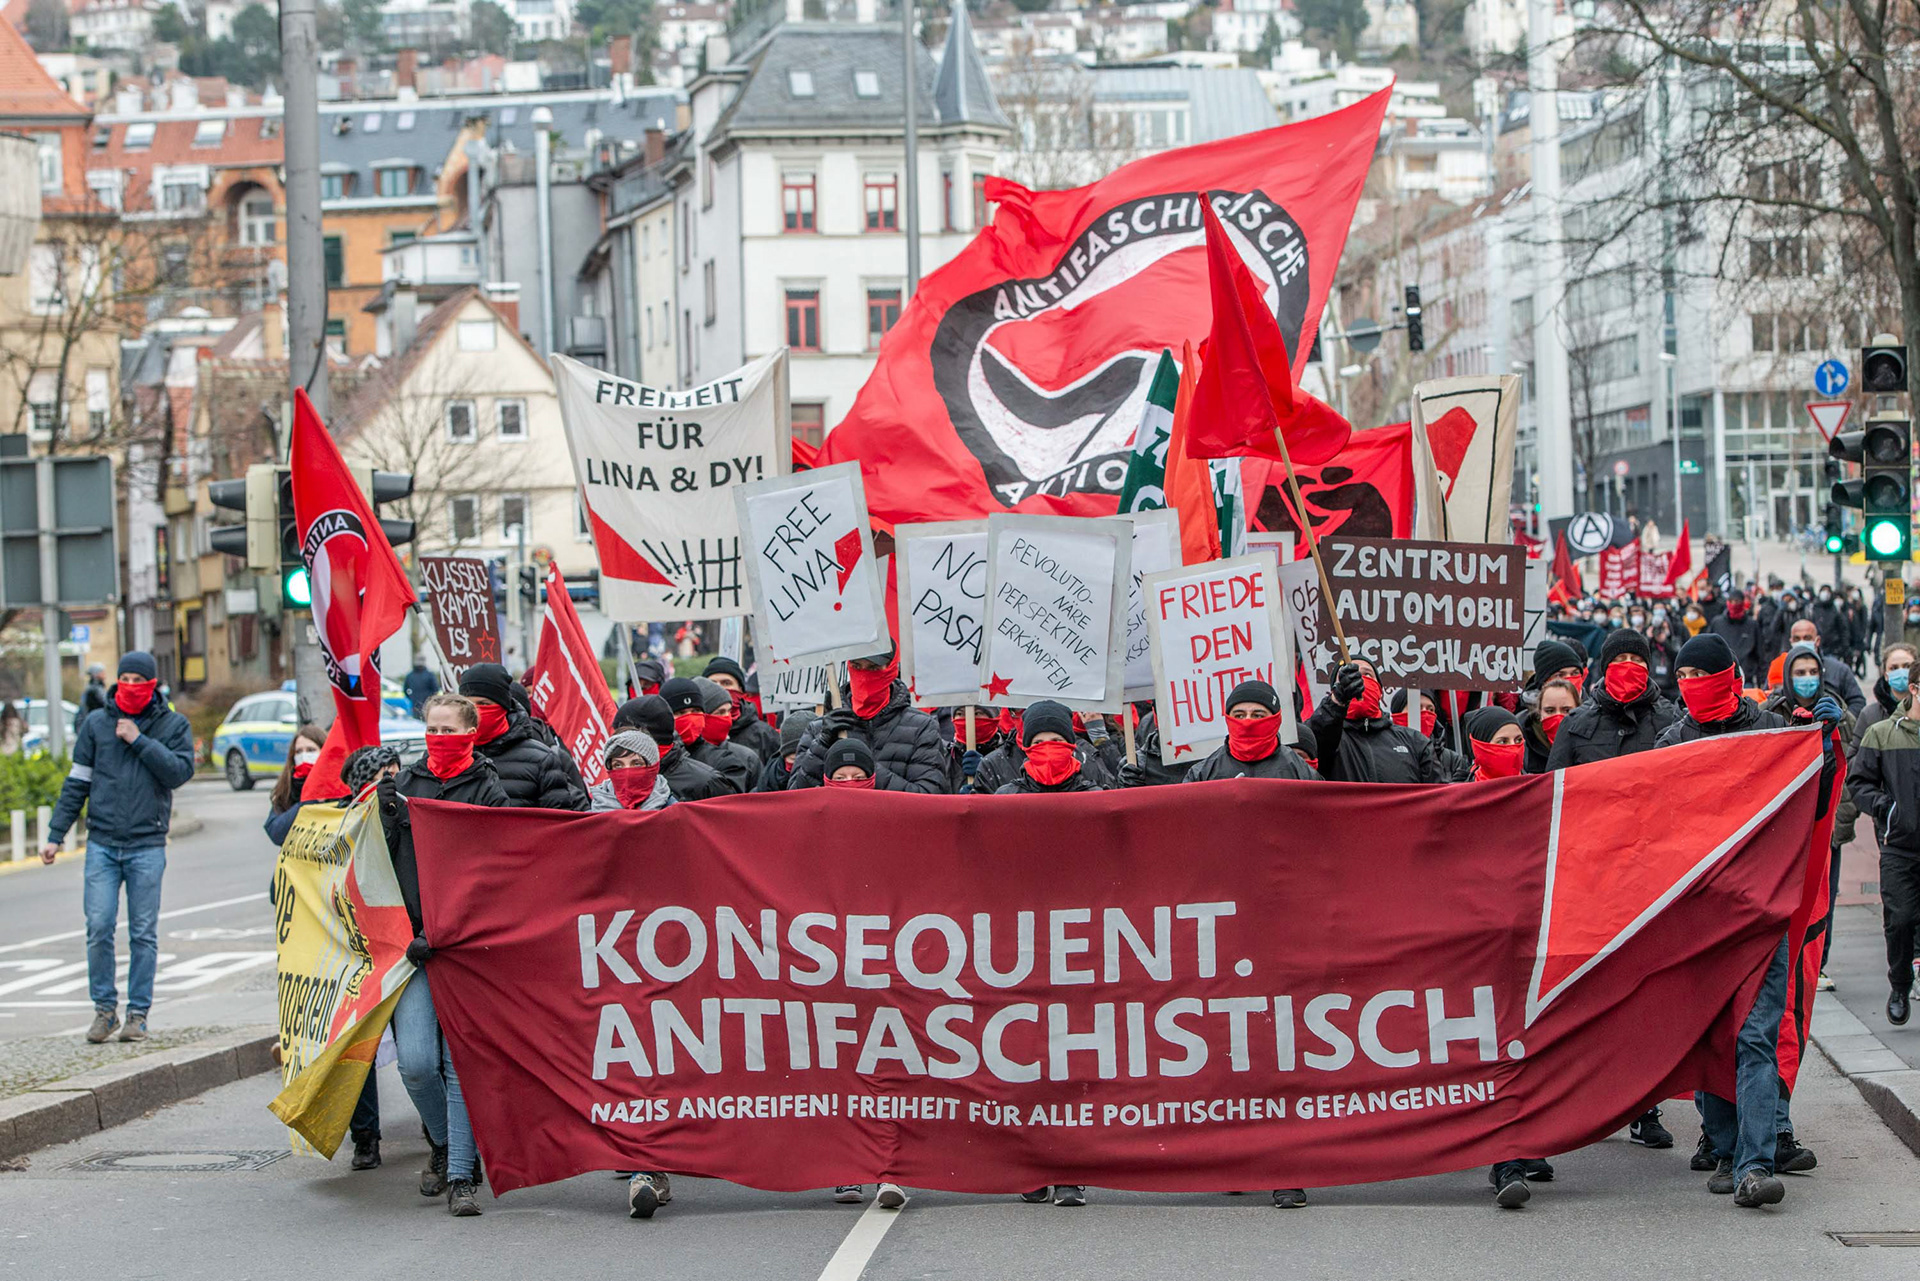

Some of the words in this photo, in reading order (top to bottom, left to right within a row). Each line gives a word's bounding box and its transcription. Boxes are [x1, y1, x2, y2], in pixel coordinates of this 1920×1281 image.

[596, 378, 743, 408] FREIHEIT
[638, 417, 704, 450] FÜR
[587, 458, 659, 492] LINA
[670, 467, 698, 492] &
[710, 455, 764, 488] DY!
[763, 490, 831, 573] FREE
[1010, 538, 1093, 604] REVOLUTIO-
[1331, 543, 1508, 585] ZENTRUM
[1053, 595, 1092, 630] NÄRE
[1159, 572, 1265, 620] FRIEDE
[1336, 589, 1520, 630] AUTOMOBIL
[997, 581, 1098, 666] PERSPEKTIVE
[1190, 621, 1253, 664] DEN
[997, 617, 1074, 692] ERKÄMPFEN
[577, 900, 1253, 999] KONSEQUENT.
[590, 985, 1526, 1082] ANTIFASCHISTISCH.
[591, 1098, 669, 1124] NAZIS
[677, 1093, 839, 1119] ANGREIFEN!
[847, 1095, 960, 1120] FREIHEIT
[969, 1100, 1022, 1127] FÜR
[1028, 1104, 1094, 1127] ALLE
[1103, 1097, 1286, 1127] POLITISCHEN
[1295, 1081, 1495, 1120] GEFANGENEN!
